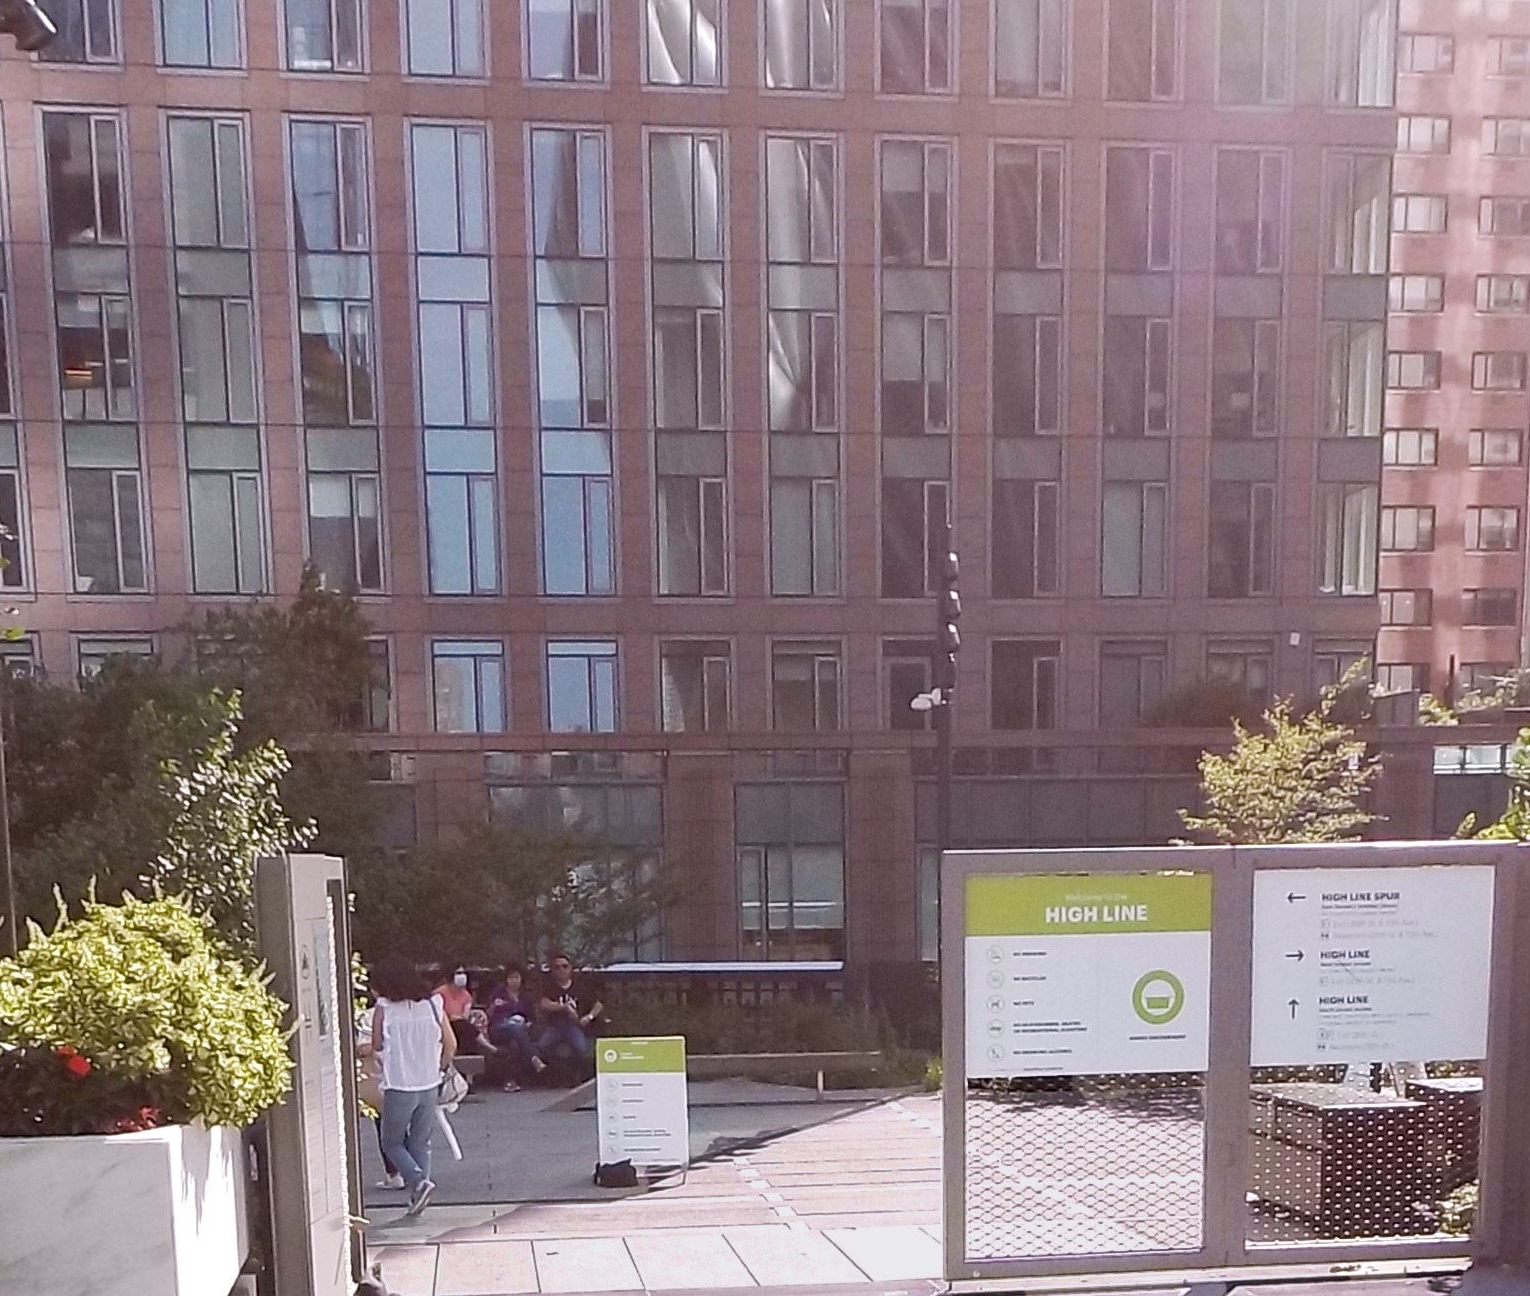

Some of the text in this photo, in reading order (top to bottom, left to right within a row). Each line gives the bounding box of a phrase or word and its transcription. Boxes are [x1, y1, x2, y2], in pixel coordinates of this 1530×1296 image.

[1321, 892, 1400, 901] HIGH LINE SPUR
[1045, 904, 1149, 923] HIGH LINE
[1320, 949, 1371, 959] HIGH LINE
[1318, 995, 1369, 1005] HIGH LINE
